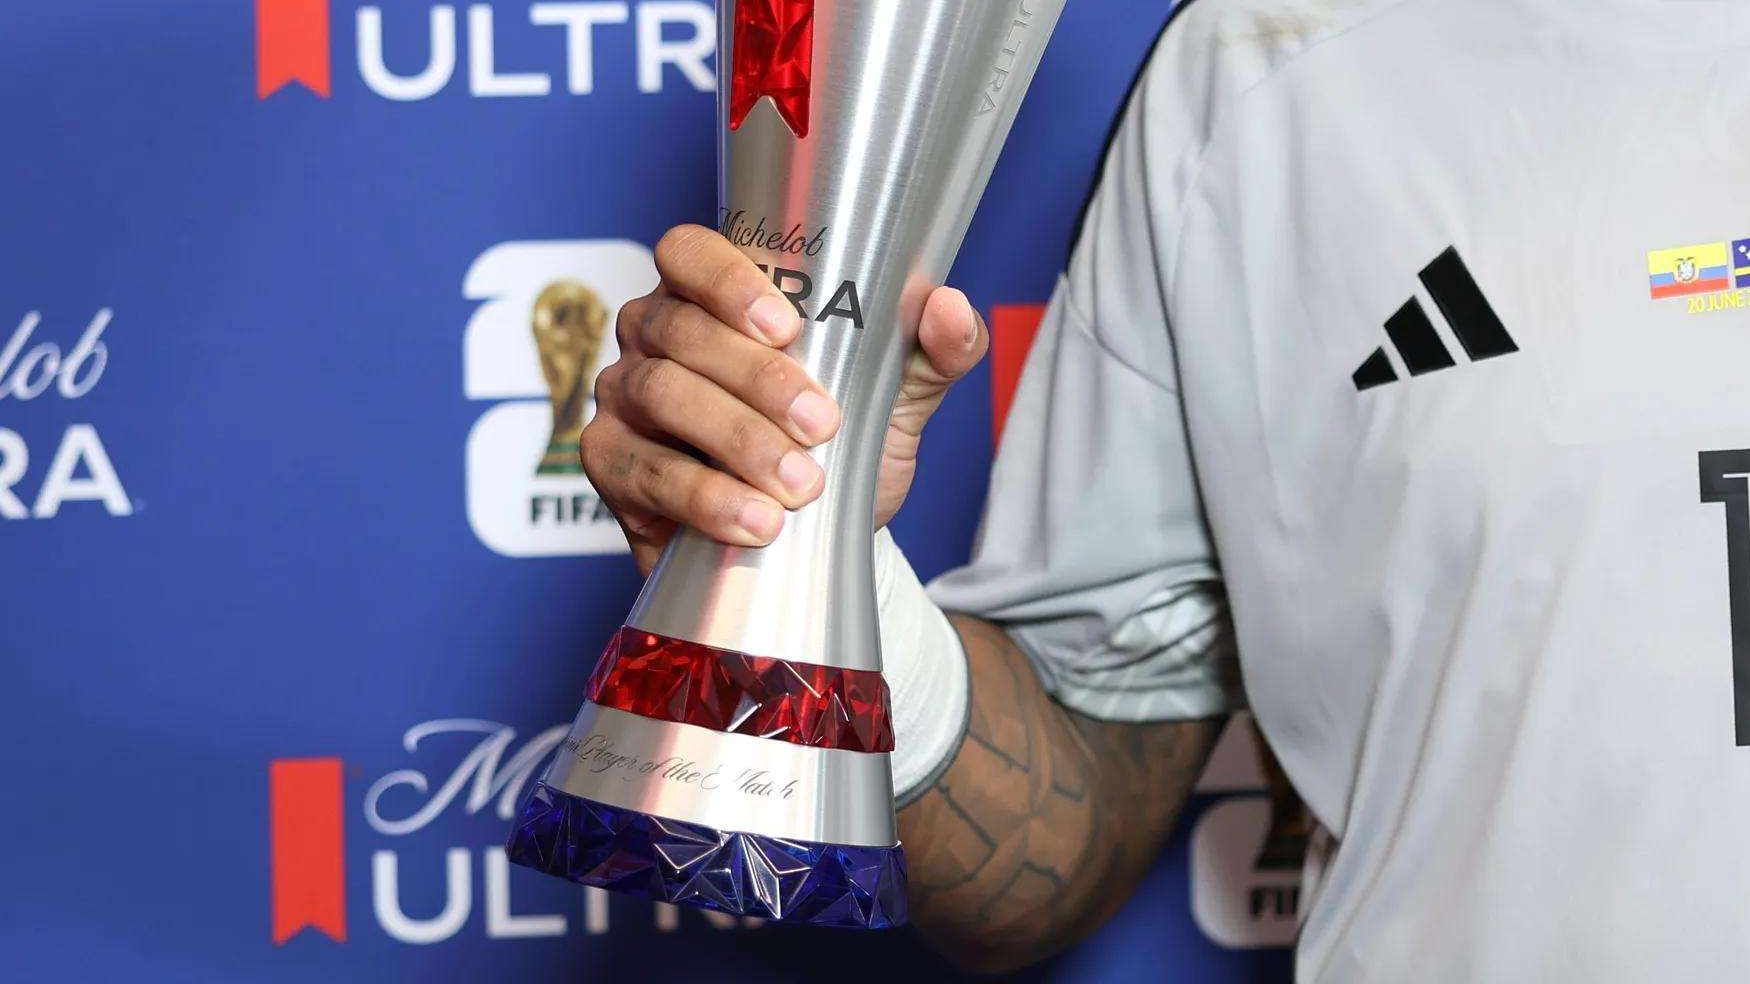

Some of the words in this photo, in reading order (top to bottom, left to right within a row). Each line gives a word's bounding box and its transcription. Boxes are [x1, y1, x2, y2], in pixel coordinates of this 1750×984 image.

[356, 0, 717, 102] ULTR
[1687, 297, 1704, 314] 20
[1706, 292, 1745, 312] JUNE
